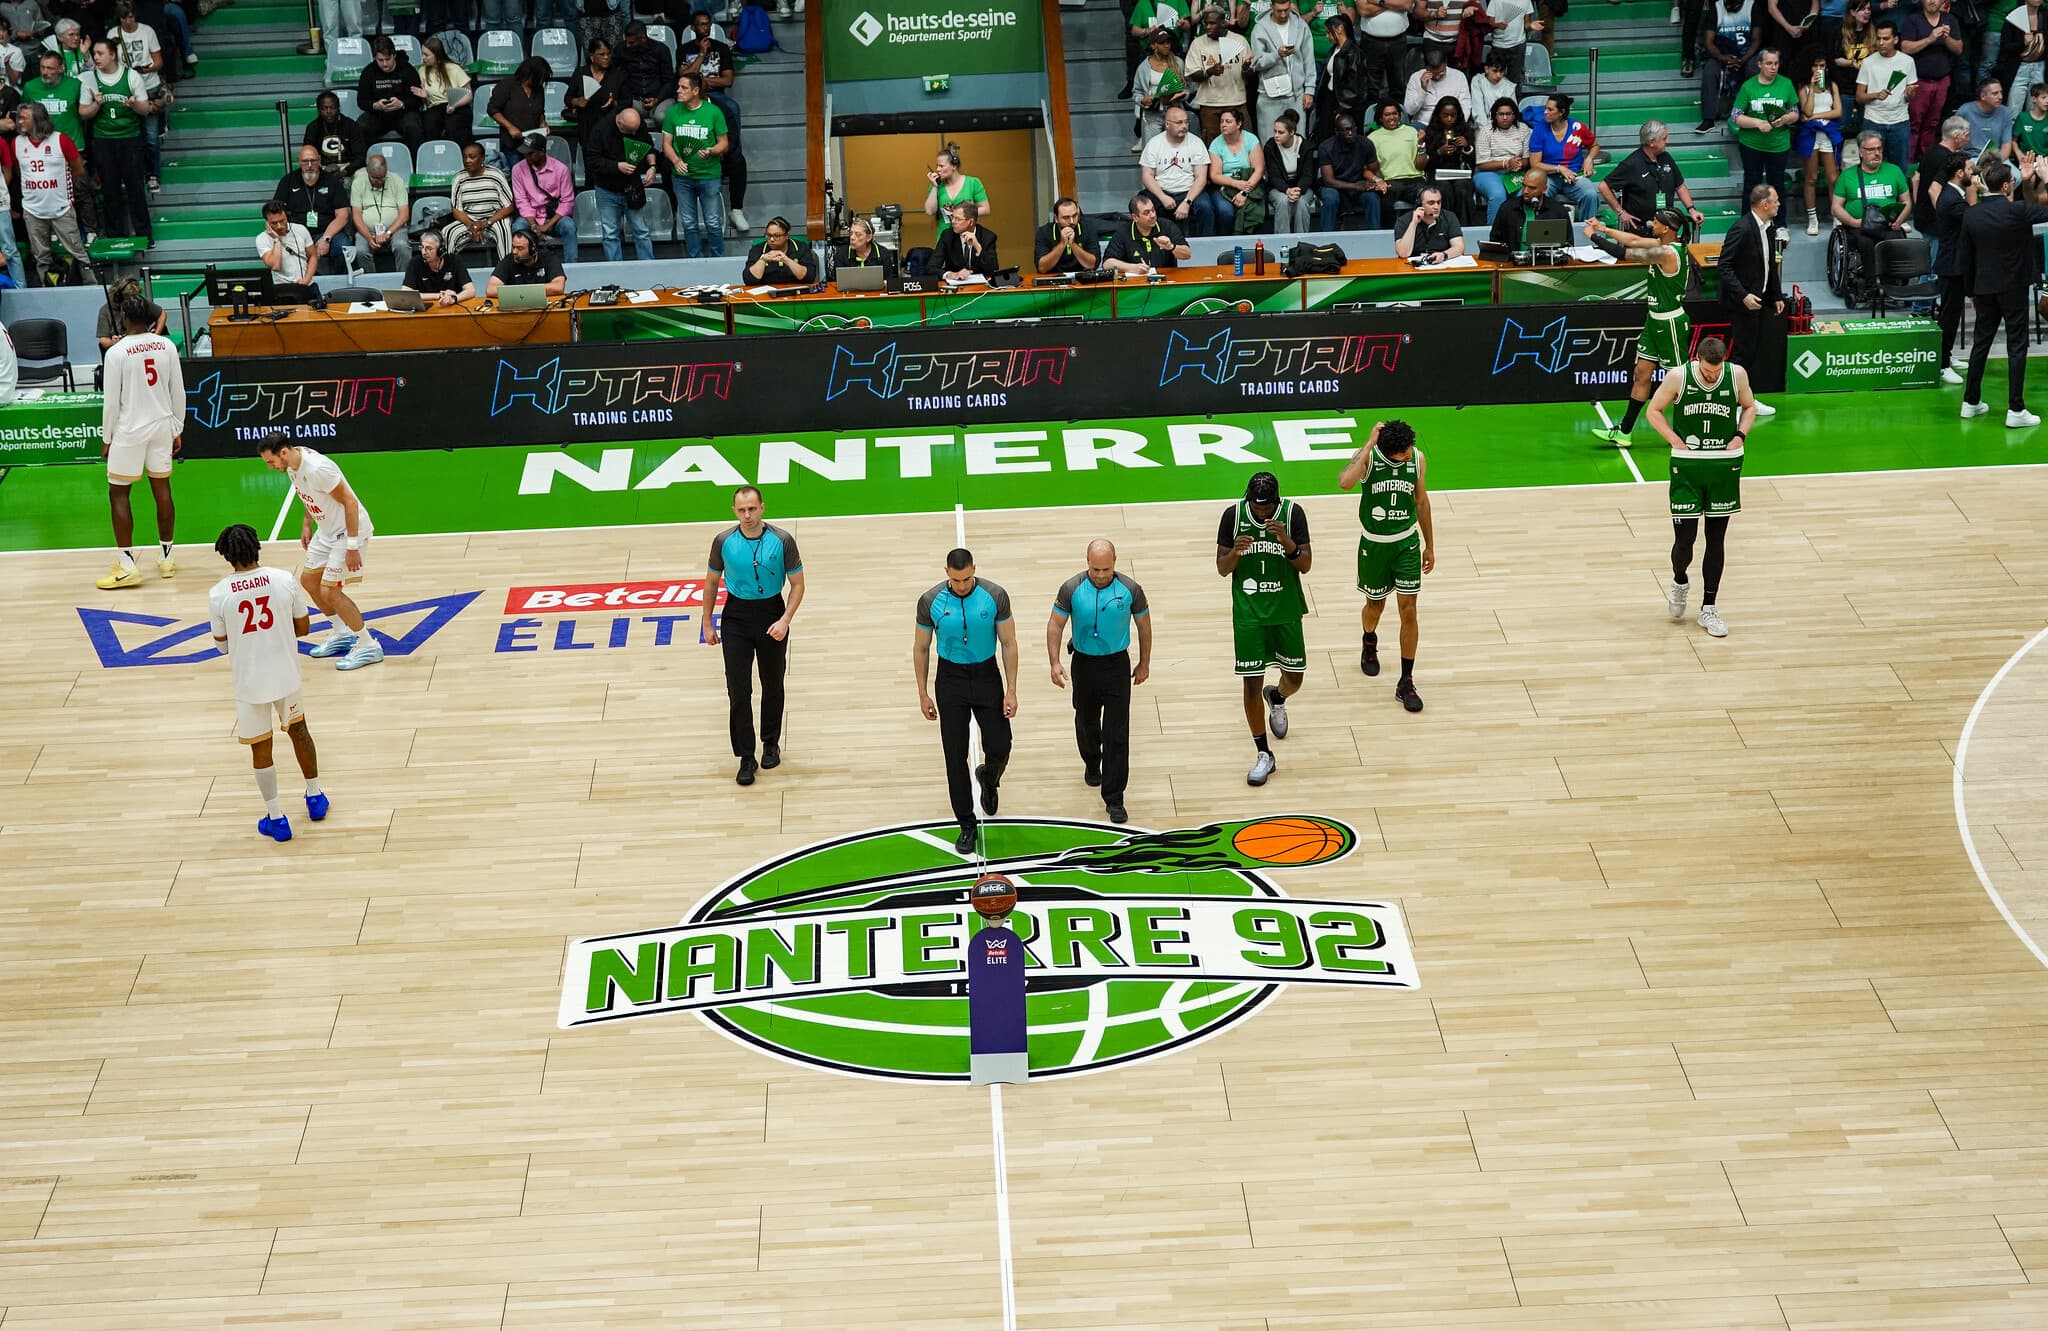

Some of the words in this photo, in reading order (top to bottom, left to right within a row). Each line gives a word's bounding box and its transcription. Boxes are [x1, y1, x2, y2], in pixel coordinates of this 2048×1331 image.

[889, 31, 955, 44] Département
[958, 29, 993, 41] Sportif
[1736, 32, 1746, 45] 5
[30, 160, 45, 172] 32
[126, 341, 166, 356] MAKOUNDOU
[144, 358, 158, 387] 5
[1573, 370, 1628, 385] TRADING
[1825, 366, 1884, 377] Département
[1885, 364, 1916, 375] Sportif
[1240, 381, 1295, 396] TRADING
[1299, 379, 1340, 393] CARDS
[907, 396, 962, 410] TRADING
[966, 393, 1007, 407] CARDS
[572, 411, 628, 426] TRADING
[632, 408, 674, 423] CARDS
[295, 423, 338, 439] CARDS
[1702, 419, 1711, 434] 11
[56, 438, 87, 450] Sportif
[517, 417, 1361, 495] NANTERRE
[1390, 492, 1397, 507] 0
[1388, 509, 1408, 517] GTM
[1260, 560, 1265, 575] 1
[231, 576, 270, 593] BEGARIN
[1259, 580, 1281, 589] GTM
[238, 595, 274, 635] 23
[1231, 908, 1397, 976] 92
